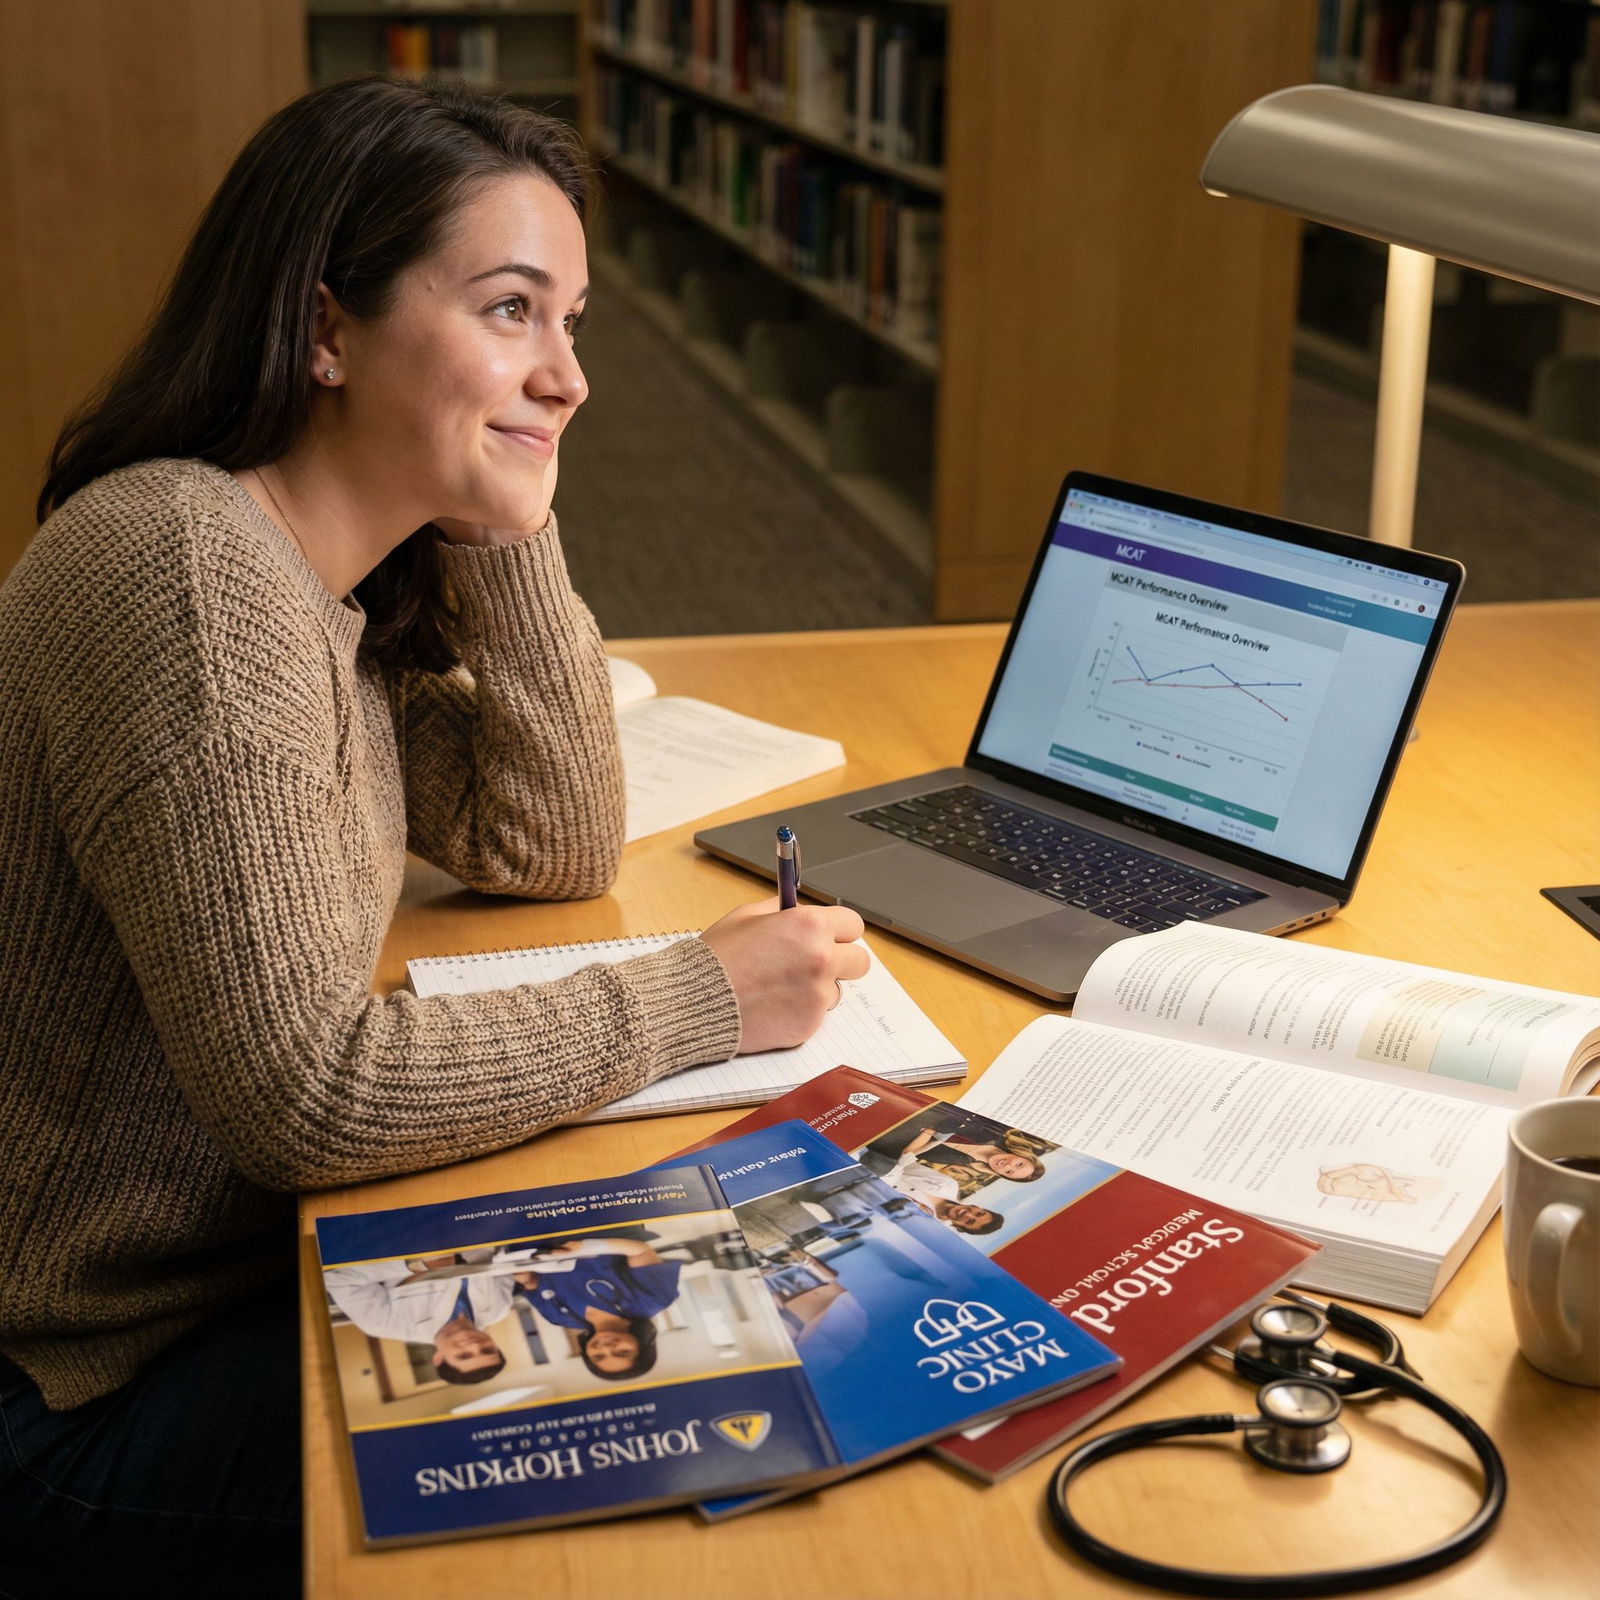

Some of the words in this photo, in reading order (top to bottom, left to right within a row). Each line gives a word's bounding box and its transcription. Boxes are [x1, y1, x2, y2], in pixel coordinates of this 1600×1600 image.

[1115, 544, 1147, 561] MCAT
[1110, 572, 1135, 587] MCAT
[1135, 578, 1187, 602] Performance
[1189, 592, 1229, 613] Overview
[1155, 612, 1181, 628] MCAT
[1180, 619, 1231, 642] Performance
[1231, 632, 1270, 653] Overview
[1070, 1218, 1244, 1334] Stanford
[916, 1320, 1046, 1379] CLINIC
[953, 1338, 1070, 1394] MAYO
[588, 1419, 702, 1470] JOHNS
[415, 1447, 586, 1496] HOPKINS
